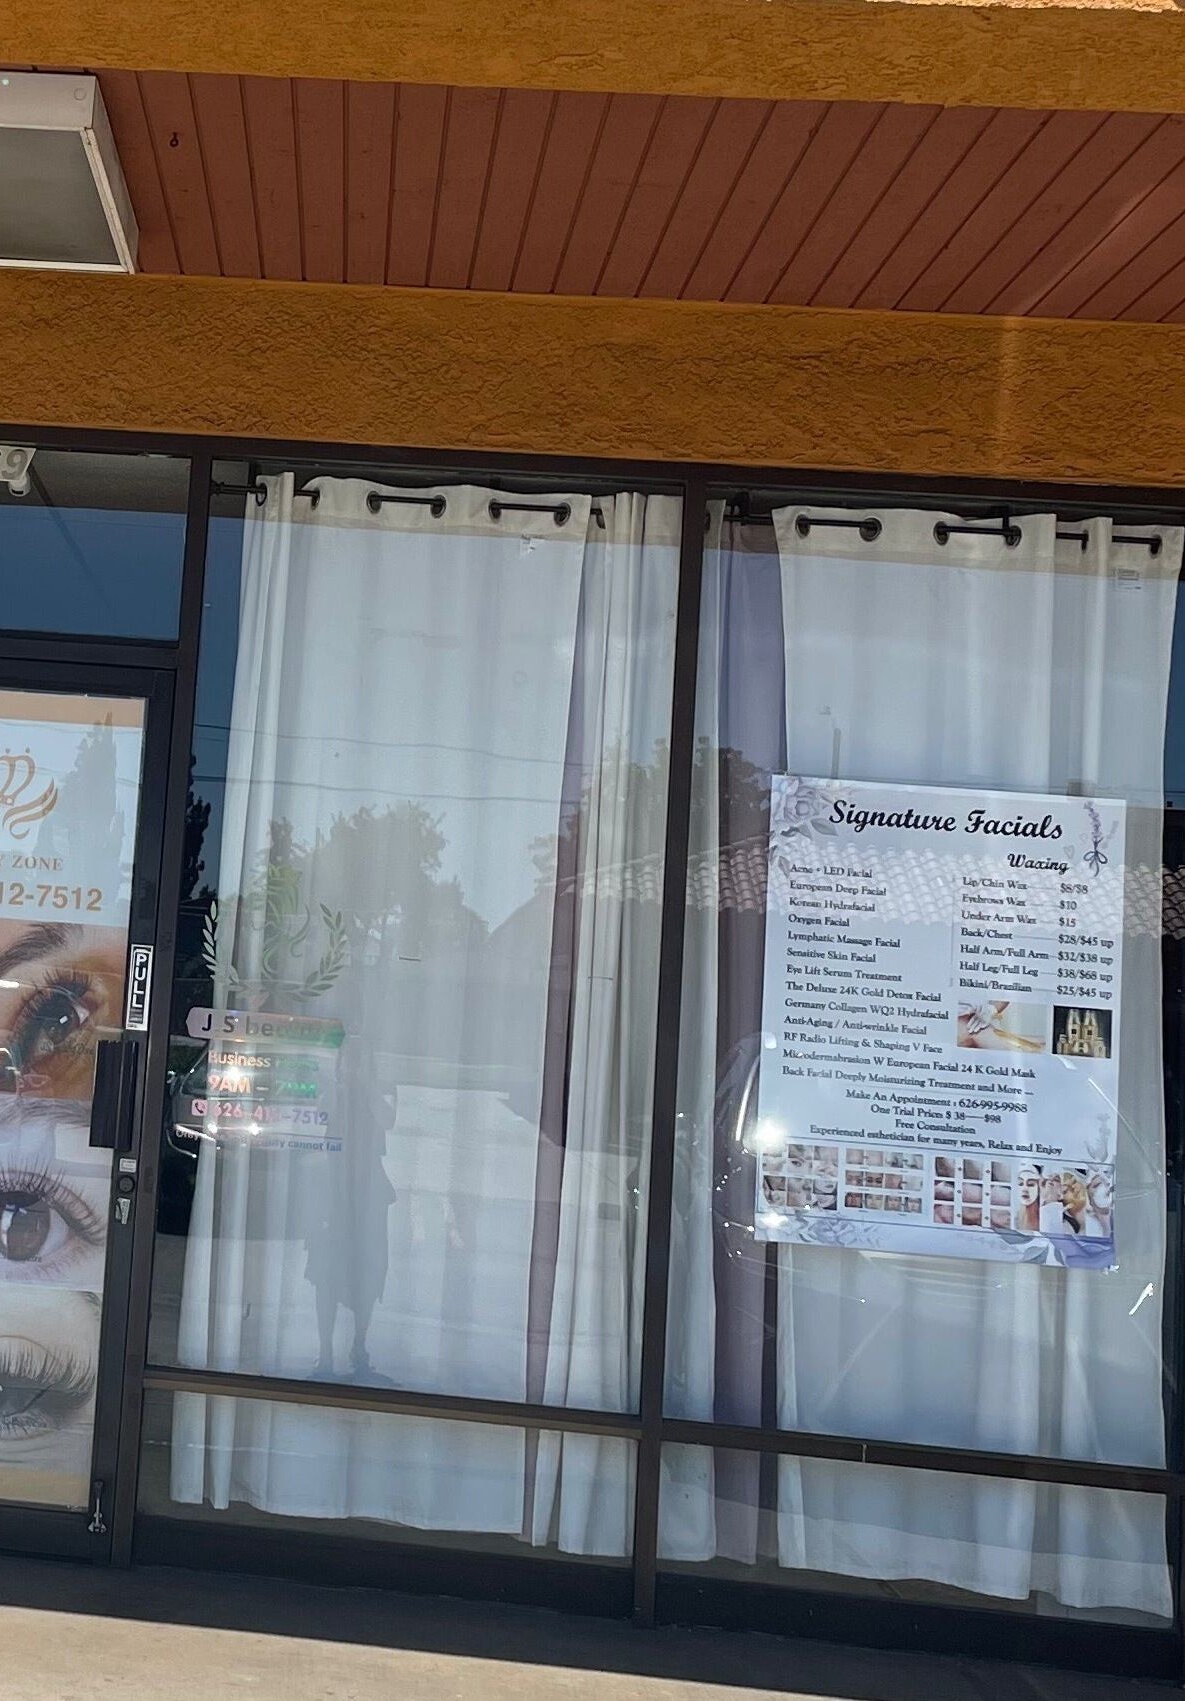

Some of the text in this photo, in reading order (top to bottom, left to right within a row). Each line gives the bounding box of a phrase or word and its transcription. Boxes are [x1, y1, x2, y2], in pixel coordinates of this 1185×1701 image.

[828, 799, 1063, 840] Signature Facials
[11, 856, 64, 872] ZONE
[823, 865, 845, 876] LED
[846, 868, 873, 879] Facial
[1006, 853, 1071, 875] Waxing
[789, 880, 887, 897] European Deep Facial
[789, 896, 822, 908] Korean
[1059, 900, 1078, 911] $10
[788, 913, 850, 927] Oxygen Facial
[961, 910, 991, 921] Under
[1058, 917, 1077, 928] $15
[787, 930, 901, 949] Lymphatic Massage Facial
[960, 926, 1114, 949] Back/Chest $28/$45 up
[786, 947, 877, 963] Sensitive Skin Facial
[959, 943, 980, 954] Half
[982, 945, 1026, 958] Arm/Full
[1027, 951, 1049, 960] Arm
[1100, 956, 1114, 966] up
[131, 953, 148, 1008] PULL
[786, 964, 903, 982] Eye Lift Serum Treatment
[959, 960, 980, 971] Half
[981, 961, 1020, 974] Leg/Full
[1022, 966, 1039, 978] Leg
[1099, 973, 1113, 983] up
[785, 980, 942, 1002] The Deluxe 24K Gold Detox Facial
[1056, 984, 1097, 998] $25/$45
[1099, 990, 1113, 1000] up
[784, 997, 826, 1012] Germany
[828, 1001, 868, 1014] Collagen
[897, 1006, 950, 1020] Hydrafacial
[783, 1015, 834, 1029] Anti-Aging
[901, 1024, 928, 1036] Facial
[783, 1031, 943, 1054] RF Radio Lifting & Shaping V Face
[208, 1050, 272, 1068] Business
[873, 1056, 886, 1066] W
[887, 1058, 931, 1071] European
[932, 1061, 959, 1073] Facial
[961, 1063, 973, 1073] 24
[974, 1064, 984, 1074] K
[985, 1065, 1009, 1077] Gold
[1010, 1067, 1037, 1079] Mask
[782, 1065, 805, 1076] Back
[806, 1067, 833, 1079] Facial
[835, 1070, 867, 1083] Deeply
[868, 1072, 926, 1088] Moisturizing
[928, 1078, 976, 1091] Treatment
[977, 1082, 995, 1093] and
[997, 1083, 1023, 1095] More
[845, 1088, 872, 1100] Make
[873, 1091, 888, 1101] An
[889, 1092, 951, 1107] Appointment
[870, 1103, 891, 1115] One
[892, 1106, 915, 1117] Trial
[895, 1118, 977, 1135] Free Consultation
[288, 1140, 325, 1151] cannot
[325, 1141, 342, 1153] fail
[809, 1124, 865, 1138] Experienced
[917, 1133, 931, 1144] for
[932, 1137, 958, 1148] many
[987, 1139, 1014, 1151] Relax
[1015, 1142, 1033, 1153] and
[1035, 1143, 1063, 1156] Enjoy
